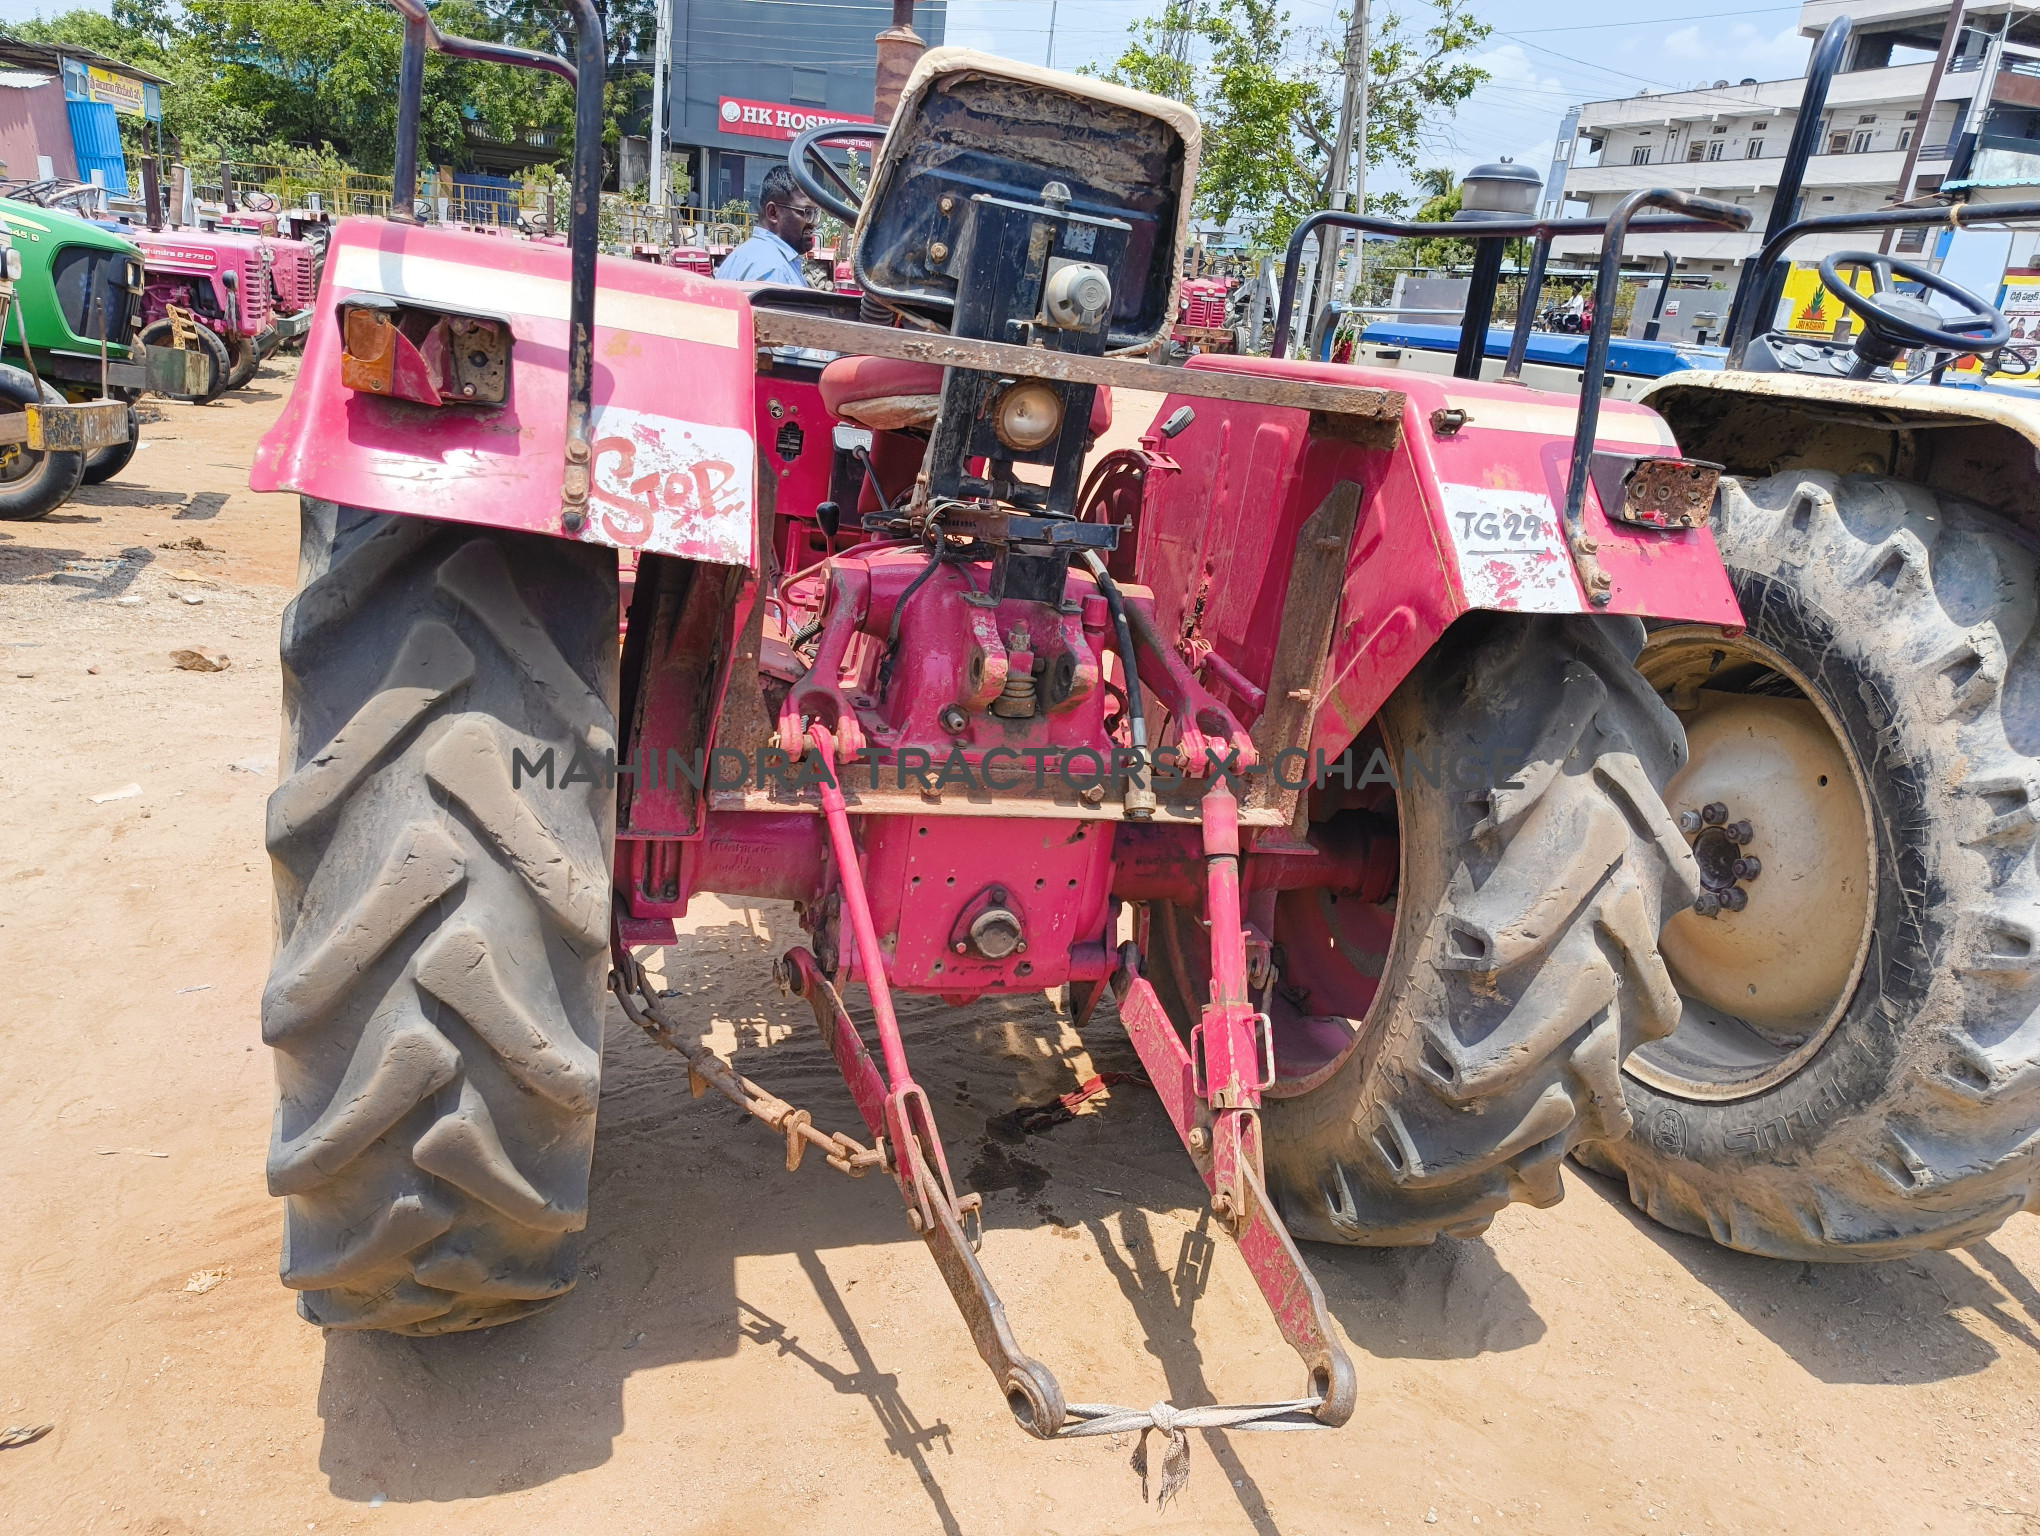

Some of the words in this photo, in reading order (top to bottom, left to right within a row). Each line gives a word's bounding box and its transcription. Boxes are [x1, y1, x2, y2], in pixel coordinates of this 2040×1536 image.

[742, 106, 773, 126] HK
[140, 247, 176, 257] ahindra
[591, 436, 736, 546] STOP
[1723, 1075, 1848, 1157] PLUS
